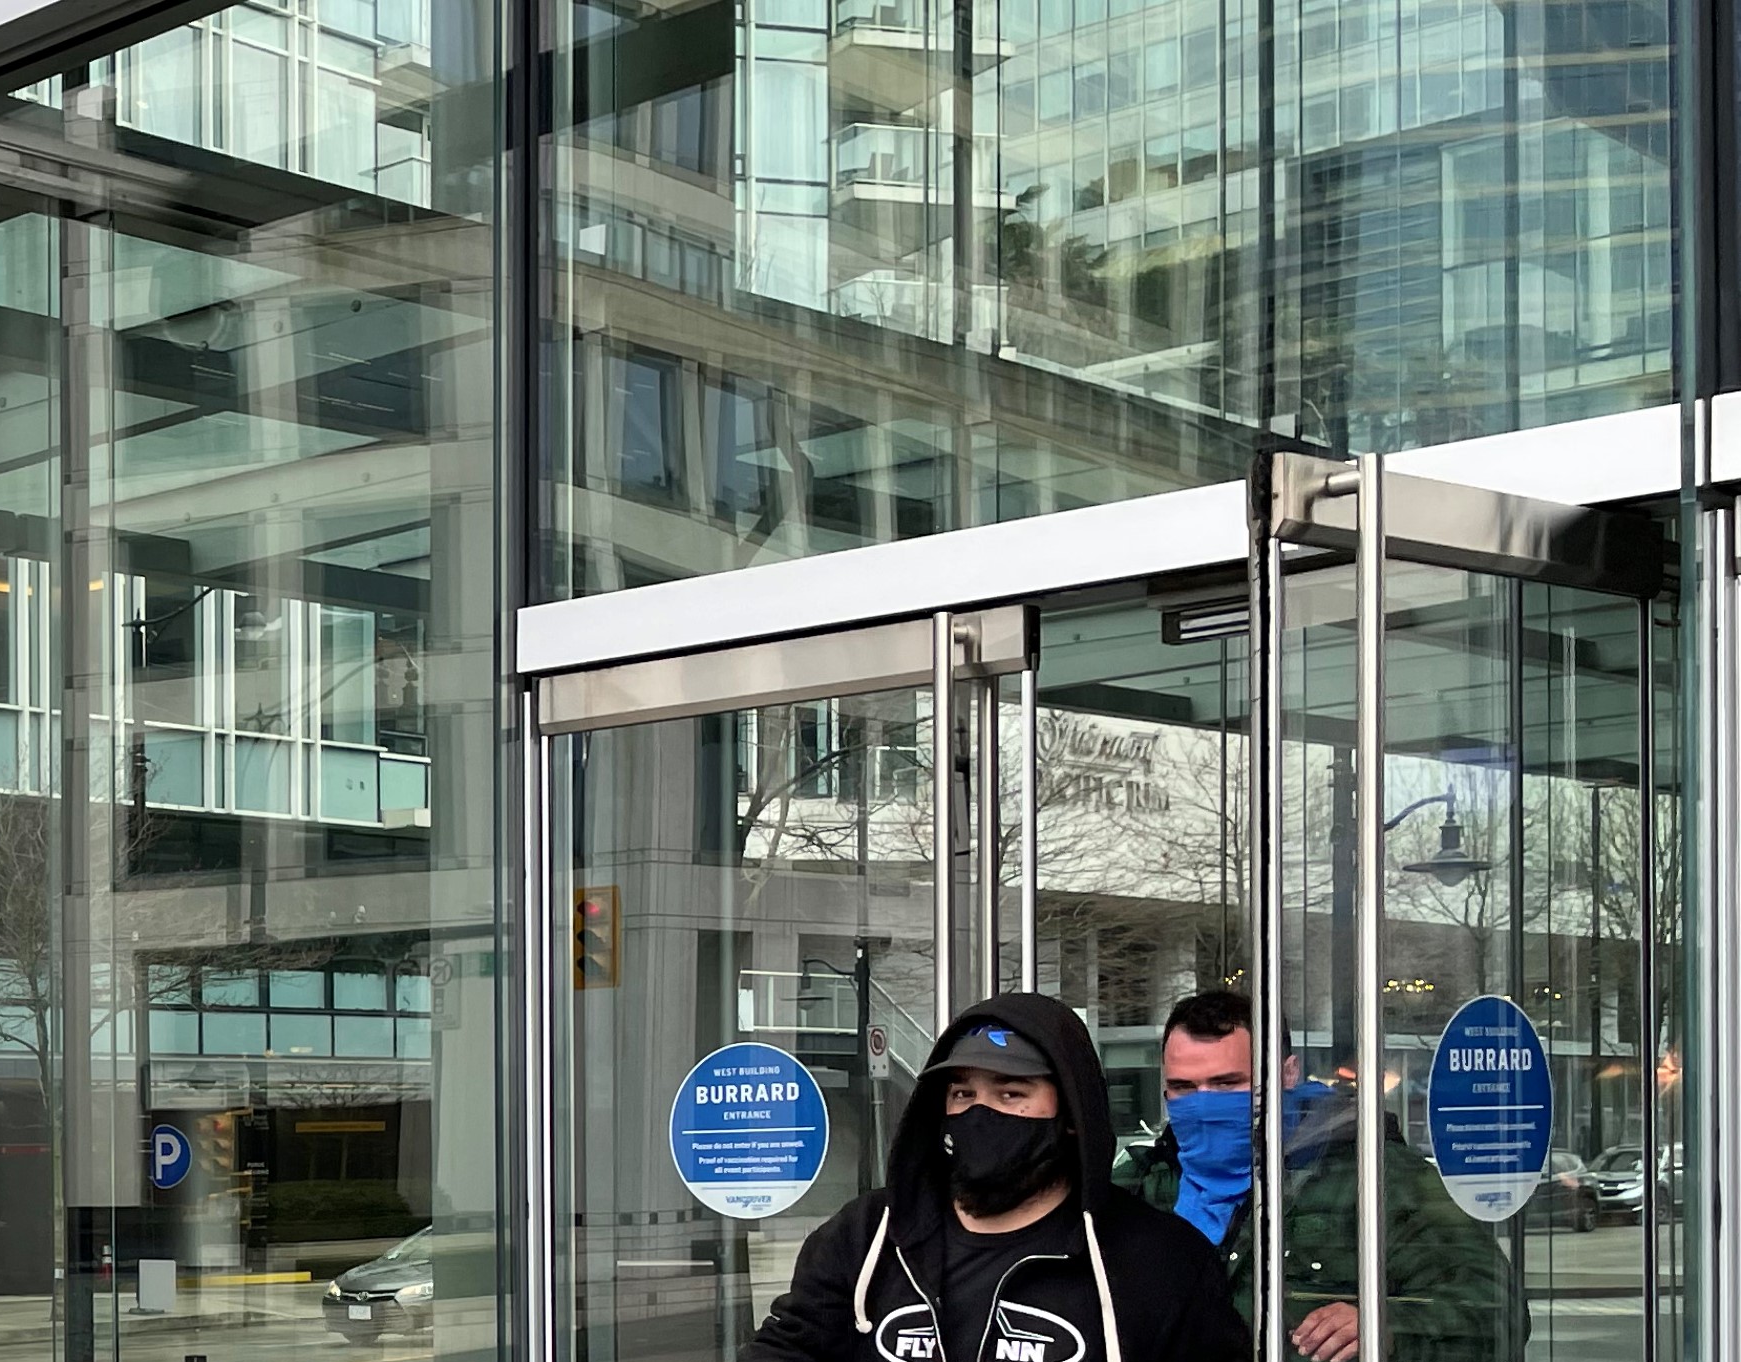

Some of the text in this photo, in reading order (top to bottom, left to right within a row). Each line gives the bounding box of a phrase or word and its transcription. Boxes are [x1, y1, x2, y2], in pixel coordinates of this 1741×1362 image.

[713, 1065, 781, 1077] WEST BUILDING
[1449, 1048, 1532, 1072] BURRARD
[696, 1082, 800, 1104] BURRARD
[723, 1110, 771, 1120] ENTRANCE
[154, 1133, 182, 1180] P
[895, 1336, 939, 1359] FLY
